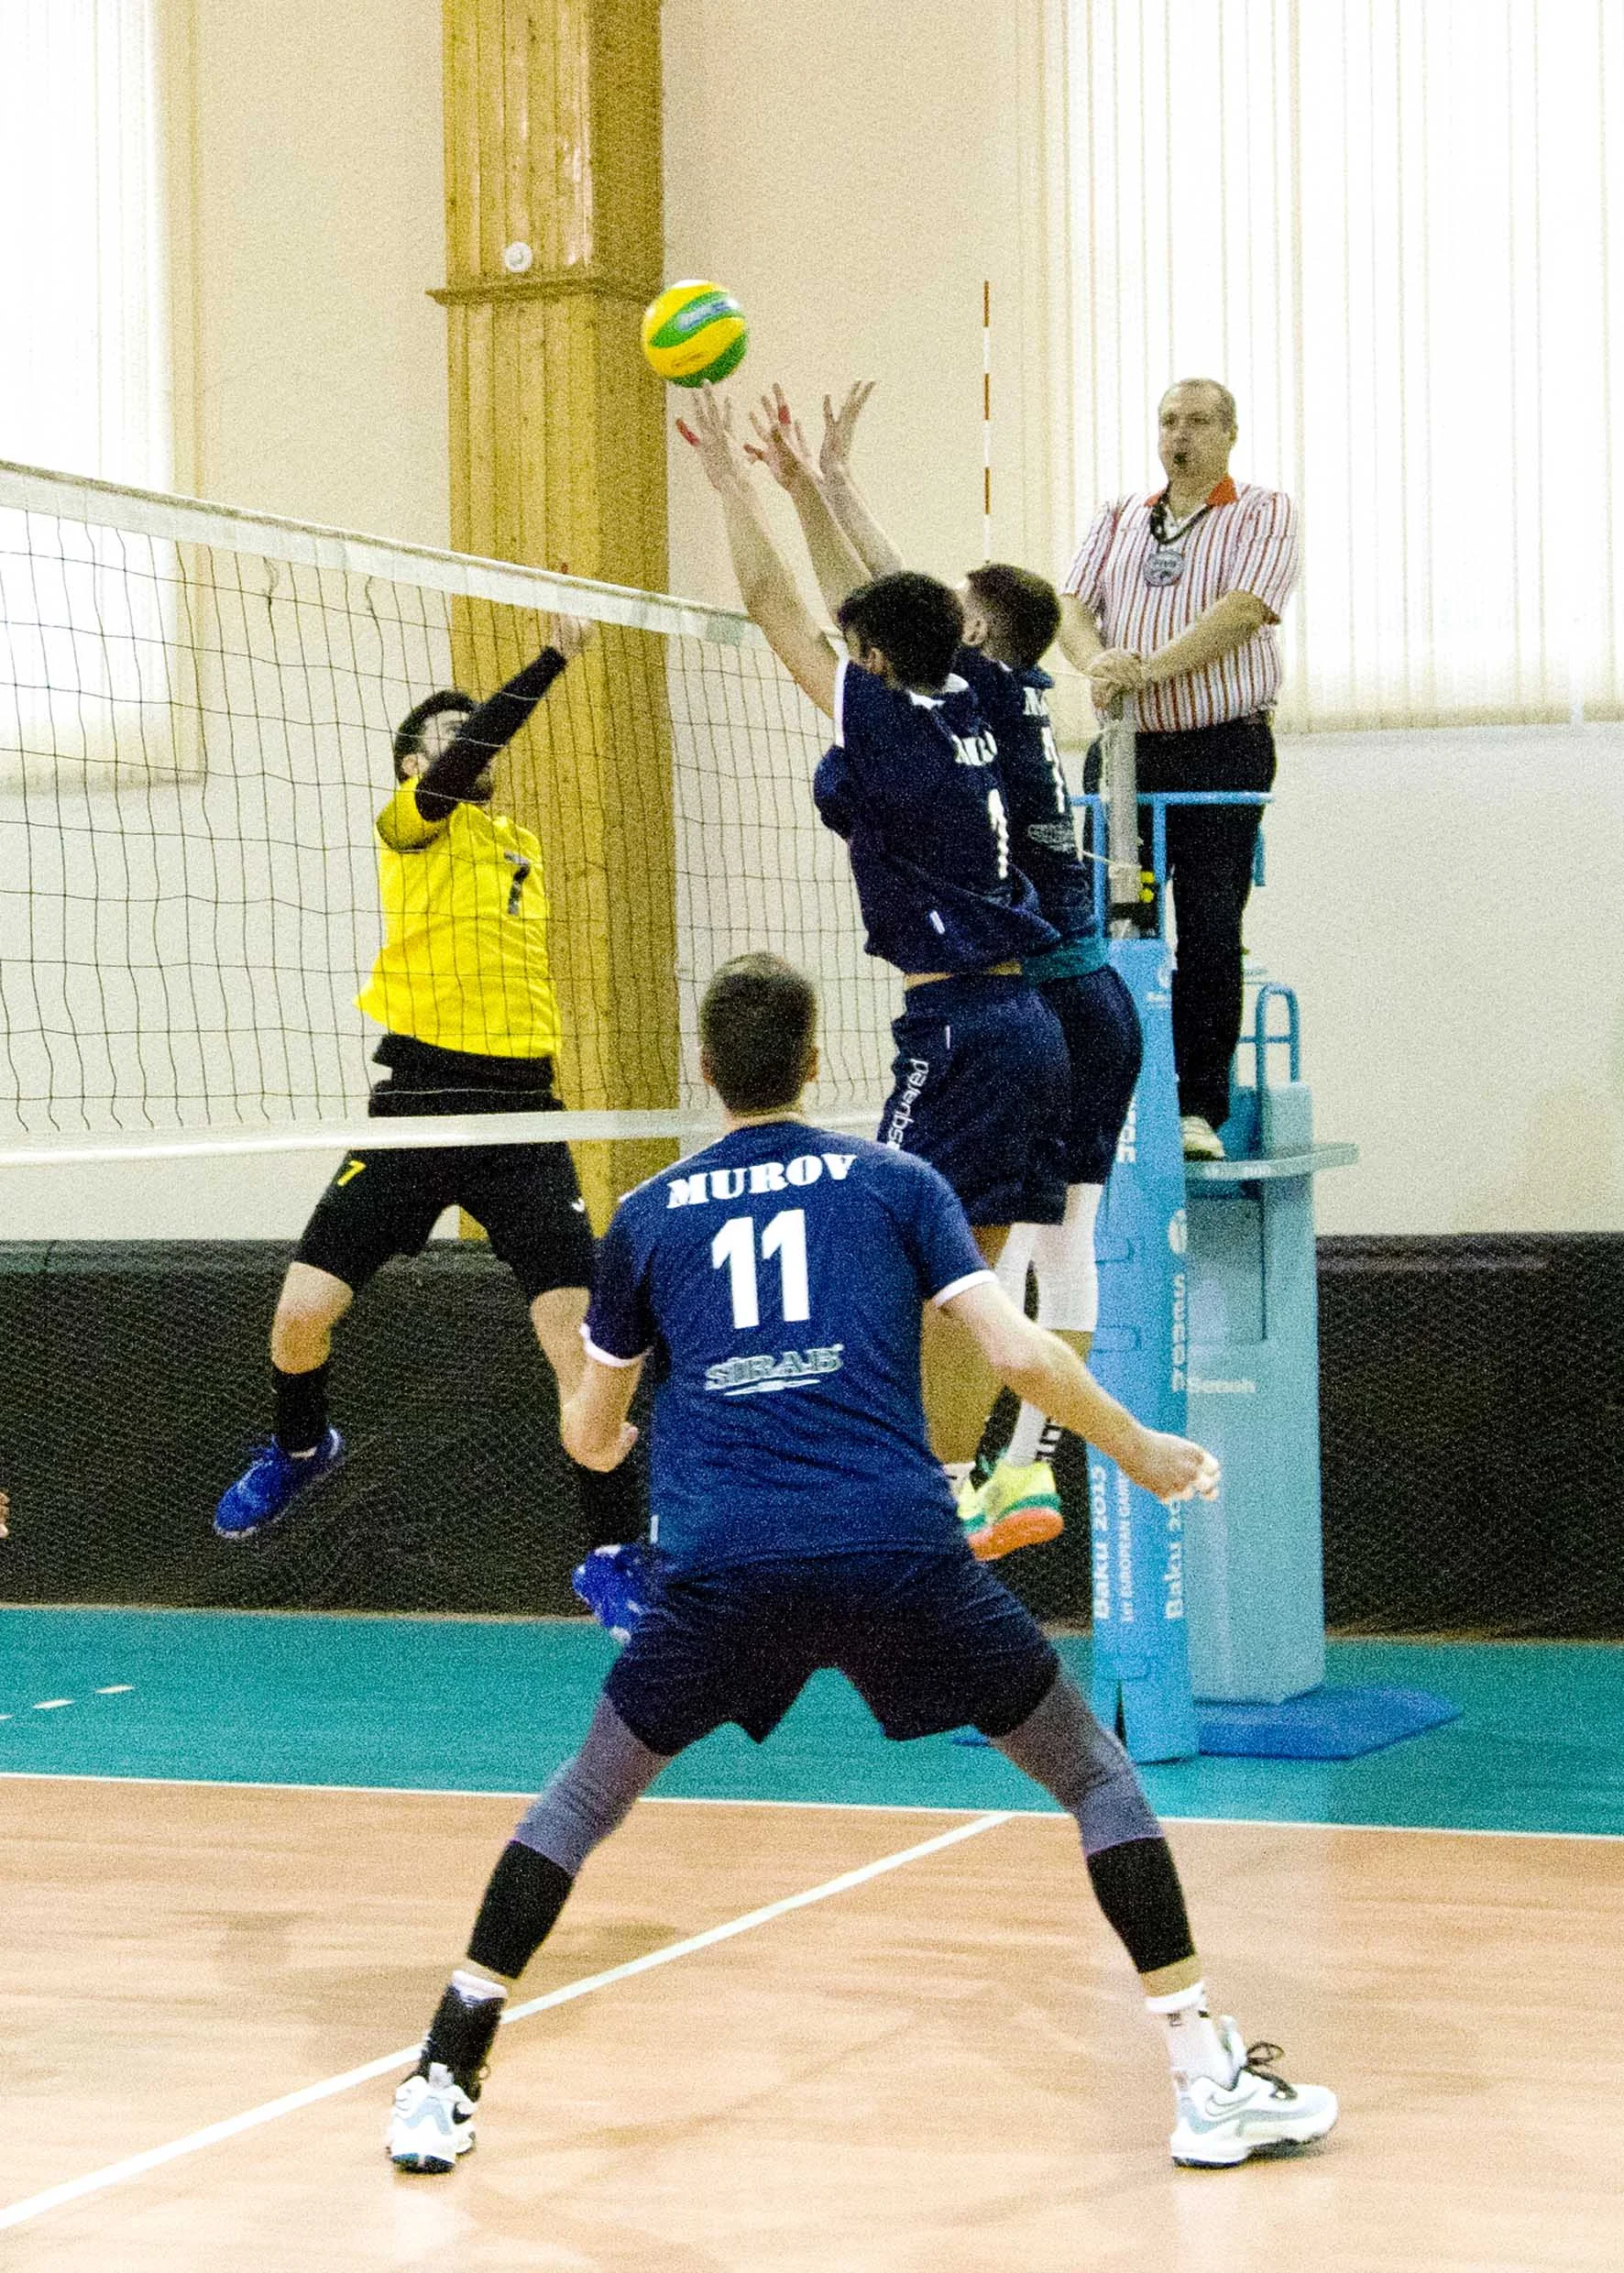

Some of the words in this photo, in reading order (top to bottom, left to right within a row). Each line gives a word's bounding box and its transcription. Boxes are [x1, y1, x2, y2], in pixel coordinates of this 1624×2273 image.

[503, 850, 531, 916] 7
[337, 1159, 367, 1187] 7
[666, 1153, 857, 1209] MUROV
[710, 1208, 810, 1330] 11
[1091, 1466, 1108, 1532] 2015
[1093, 1542, 1110, 1620] Baku
[1118, 1520, 1134, 1598] EUROPEAN
[1163, 1542, 1183, 1620] Baku
